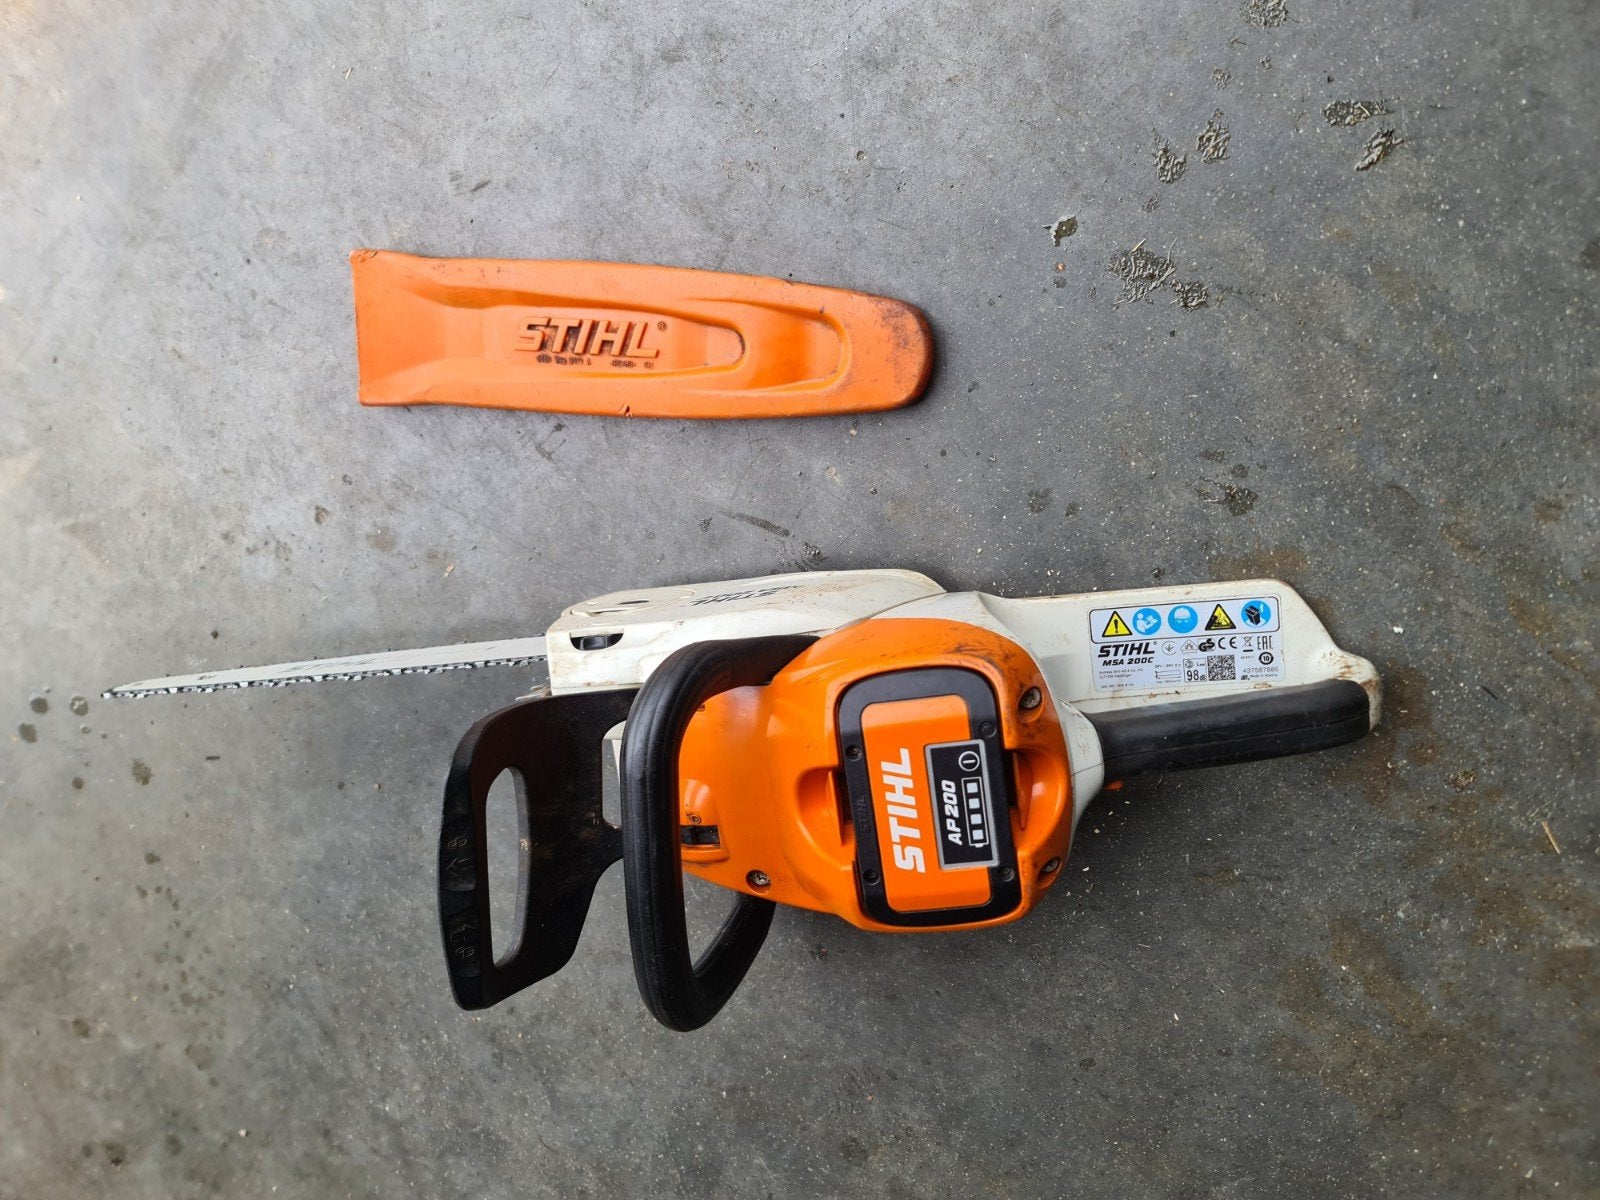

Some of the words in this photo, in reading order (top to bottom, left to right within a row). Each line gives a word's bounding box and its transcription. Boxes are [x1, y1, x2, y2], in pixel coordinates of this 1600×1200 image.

[514, 316, 660, 359] STIHL
[1097, 642, 1155, 658] STIHL
[1102, 659, 1124, 667] MSA
[1127, 657, 1155, 665] 200C
[1186, 669, 1199, 681] 98
[880, 747, 926, 874] STIHL
[941, 779, 960, 819] 200
[947, 819, 963, 846] AP
